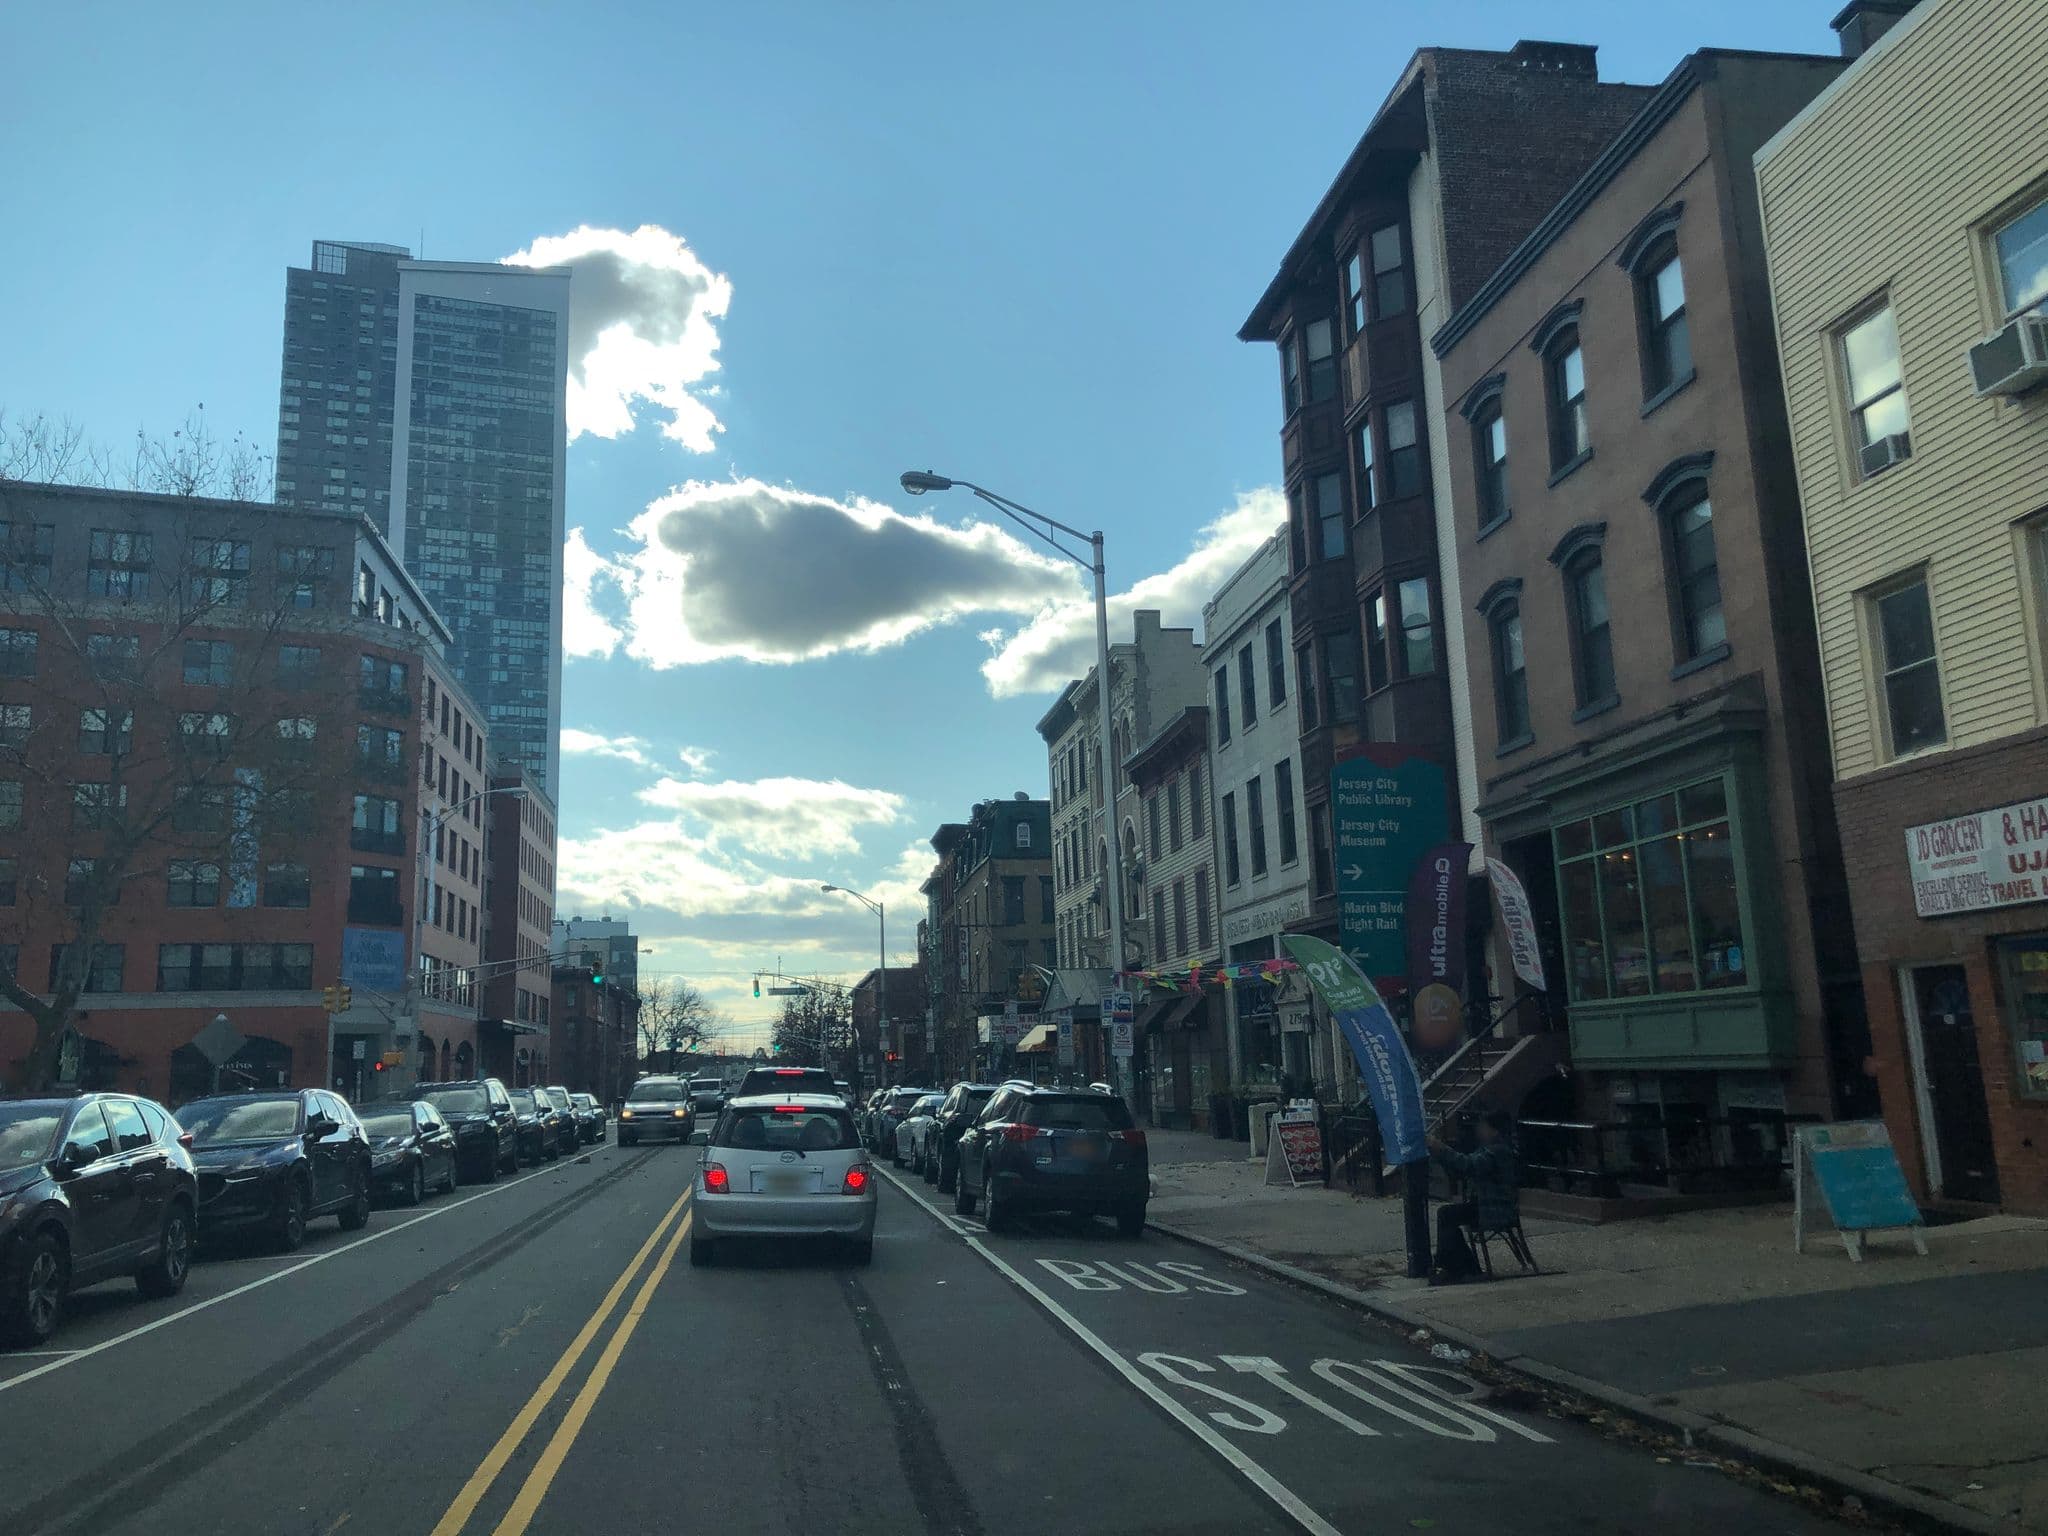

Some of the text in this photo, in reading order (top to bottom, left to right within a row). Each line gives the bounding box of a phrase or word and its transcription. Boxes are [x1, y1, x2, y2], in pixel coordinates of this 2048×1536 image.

[1338, 778, 1398, 792] Jersey City
[1338, 794, 1412, 808] Public Library
[1340, 818, 1400, 832] Jersey City
[1340, 834, 1386, 847] Museum
[1931, 817, 1984, 858] GROCERY
[2002, 812, 2018, 846] &
[1991, 878, 2037, 904] TRAVEL
[1344, 902, 1403, 914] Marin Blvd
[1345, 917, 1398, 932] Light Rail
[1035, 1257, 1249, 1297] BUS
[1136, 1352, 1558, 1443] STOP
